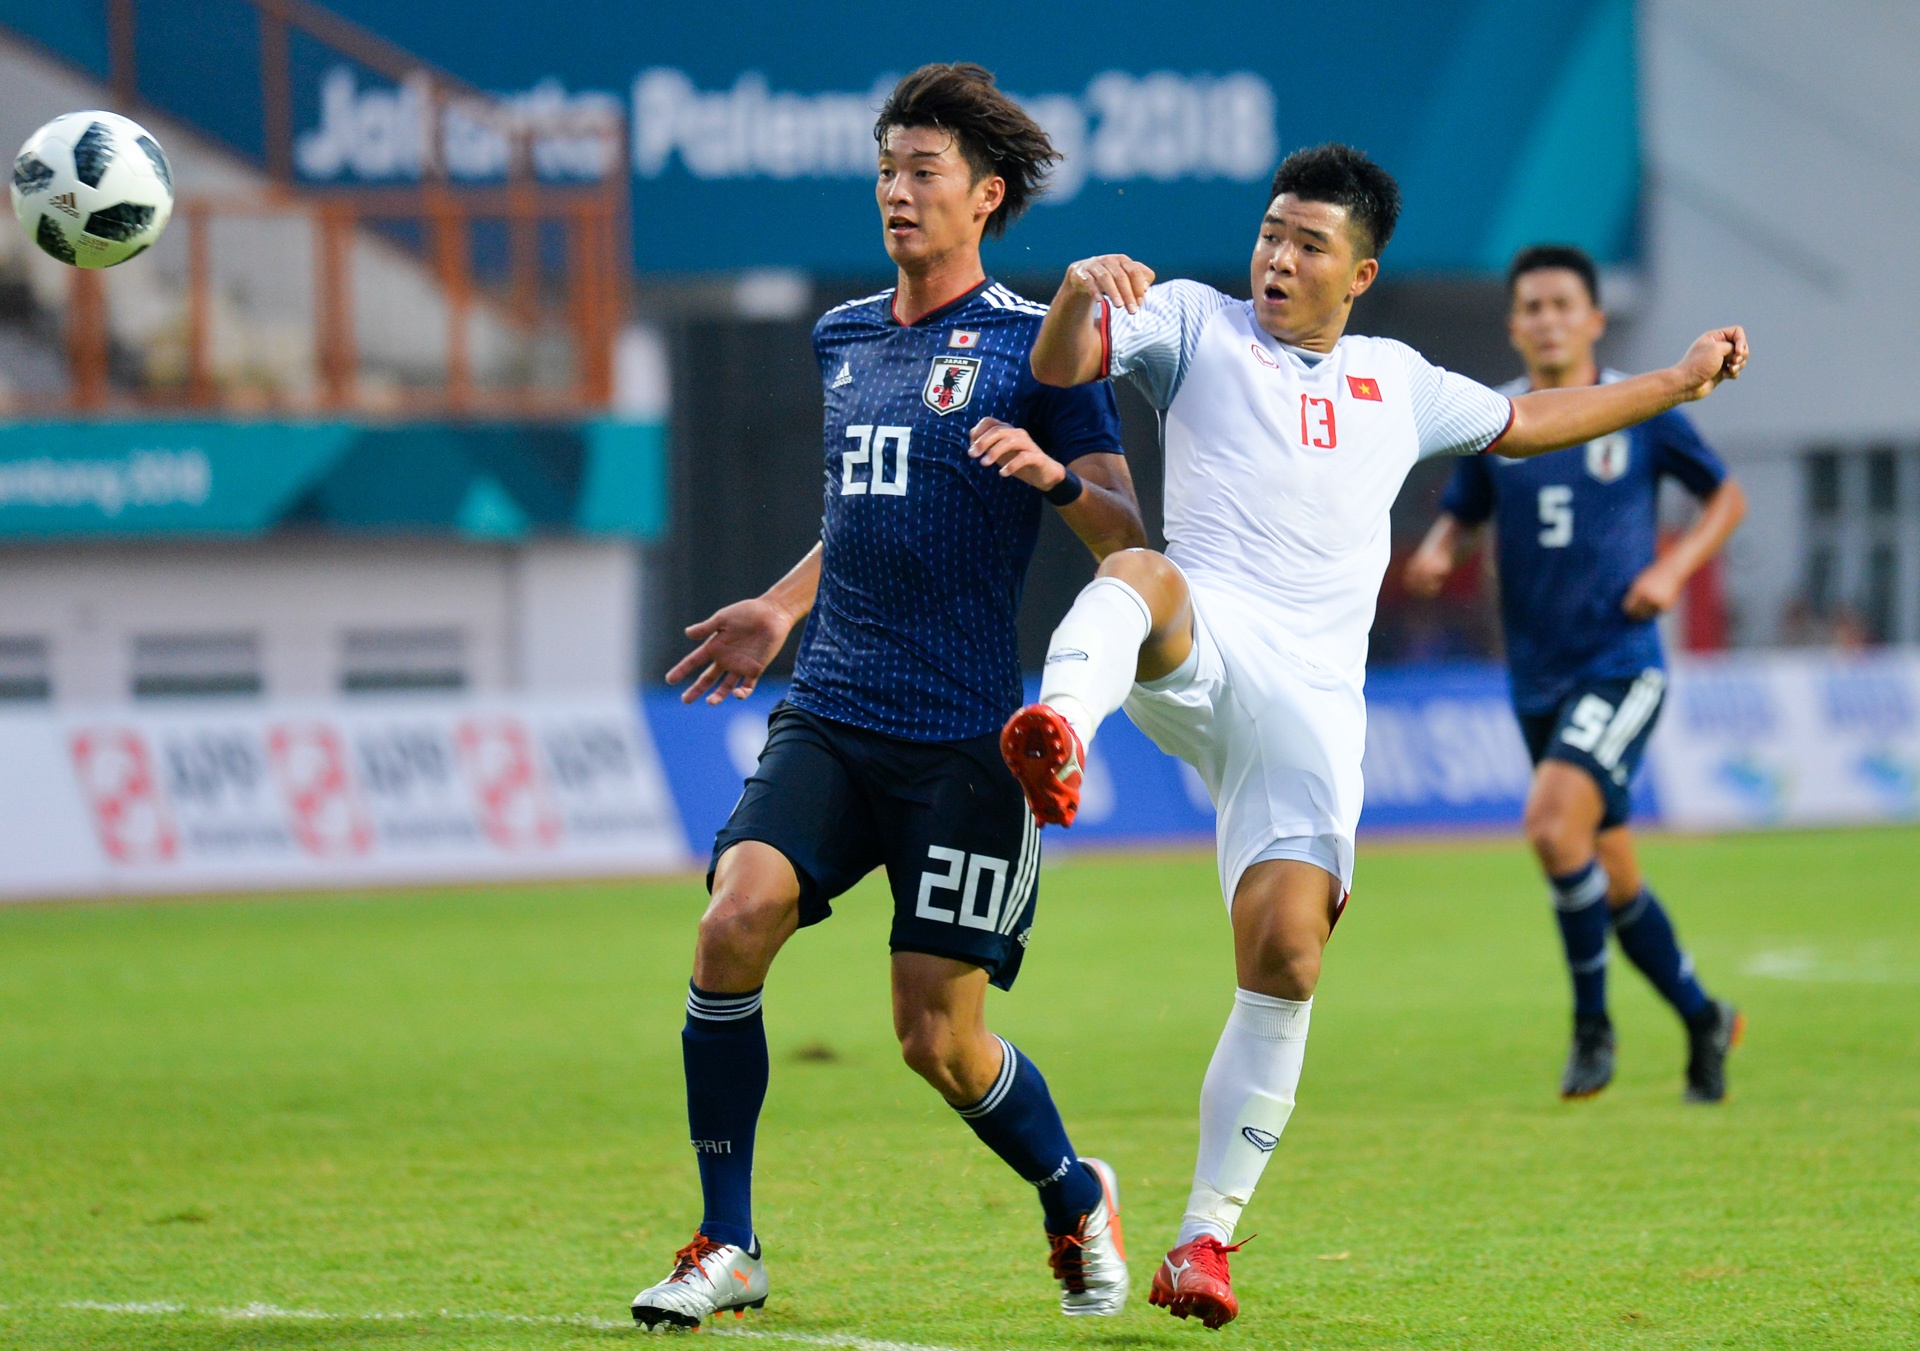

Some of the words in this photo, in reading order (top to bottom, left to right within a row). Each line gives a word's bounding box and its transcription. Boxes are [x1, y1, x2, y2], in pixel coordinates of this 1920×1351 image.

[1087, 71, 1278, 181] 2018
[934, 394, 954, 404] JFA
[1300, 393, 1337, 449] 13
[841, 425, 911, 496] 20
[1538, 485, 1574, 548] 5
[1561, 693, 1614, 753] 5
[915, 844, 1010, 933] 20
